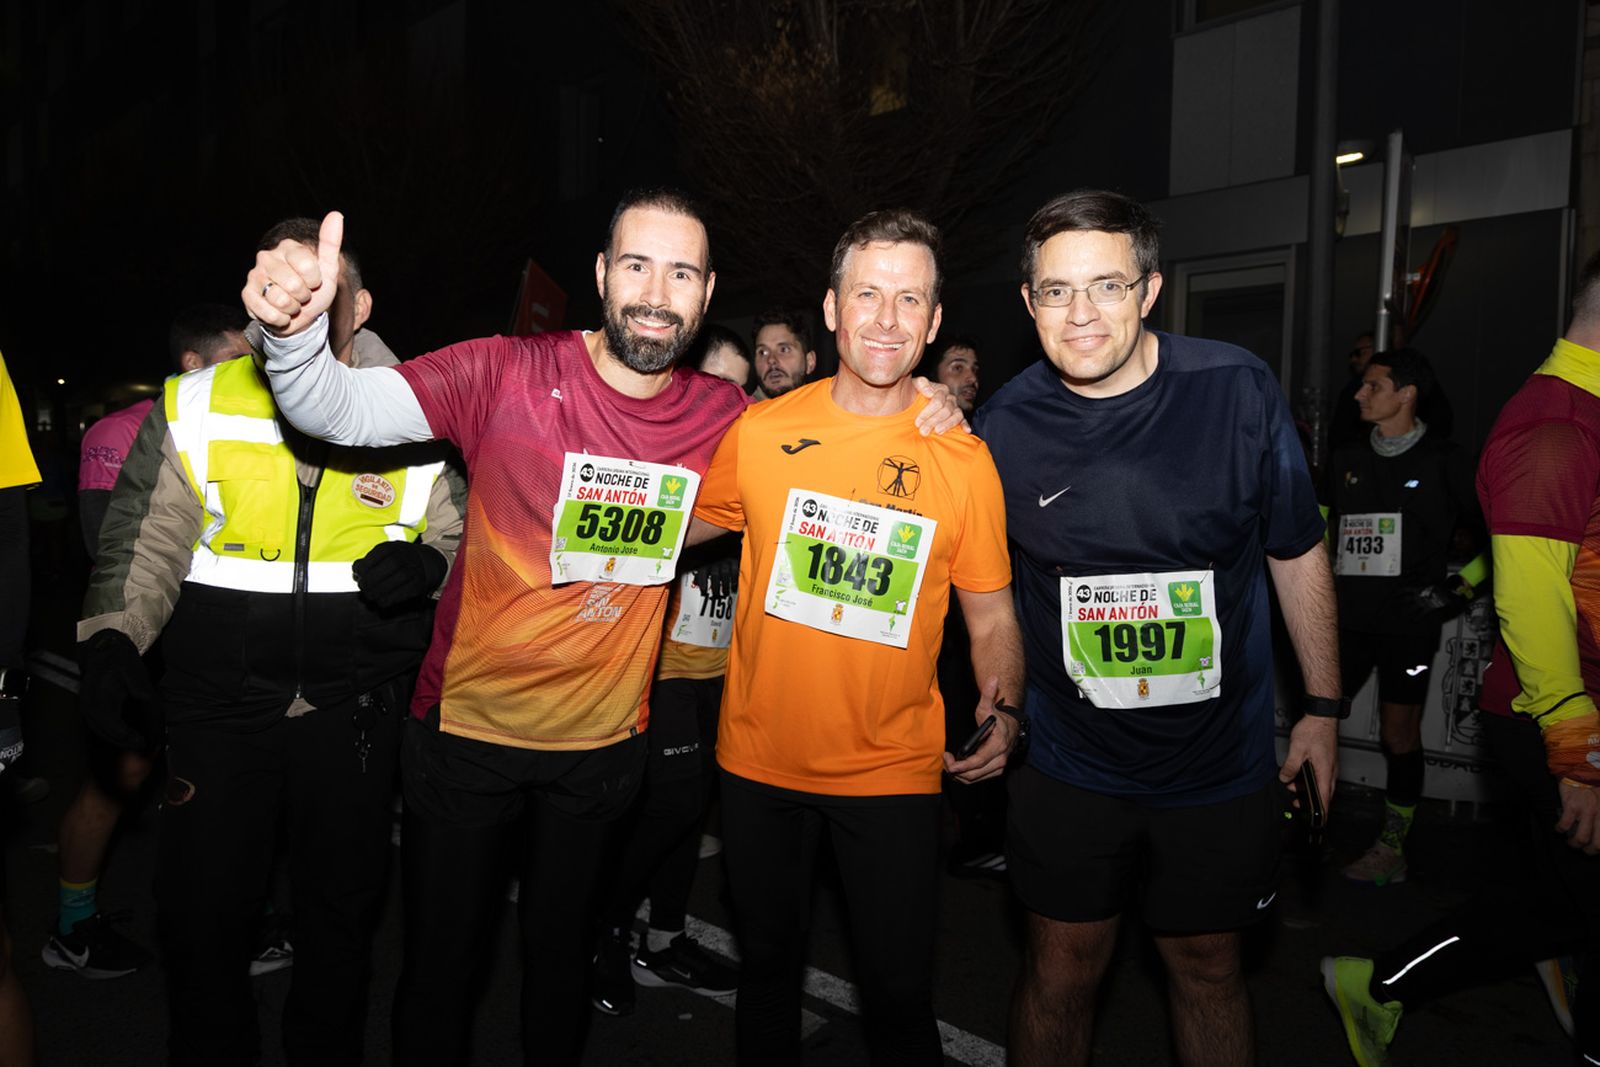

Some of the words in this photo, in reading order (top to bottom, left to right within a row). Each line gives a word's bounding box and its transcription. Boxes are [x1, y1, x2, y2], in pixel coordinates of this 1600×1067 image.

[580, 465, 594, 478] 43
[595, 473, 632, 487] NOCHE
[634, 477, 649, 489] DE
[577, 487, 604, 501] SAN
[604, 488, 647, 506] ANTÓN
[576, 503, 666, 545] 5308
[799, 522, 826, 539] SAN
[862, 520, 880, 534] DE
[590, 543, 619, 554] Antonio
[1345, 536, 1384, 555] 4133
[808, 543, 893, 596] 1843
[812, 584, 850, 602] Francisco
[852, 595, 873, 607] José
[1077, 587, 1091, 600] 43
[1094, 589, 1137, 603] NOCHE
[1140, 588, 1157, 602] DE
[700, 593, 733, 620] 7158
[1078, 606, 1105, 621] SAN
[1108, 602, 1158, 620] ANTÓN
[1094, 621, 1186, 662] 1997
[1130, 666, 1153, 675] Juan
